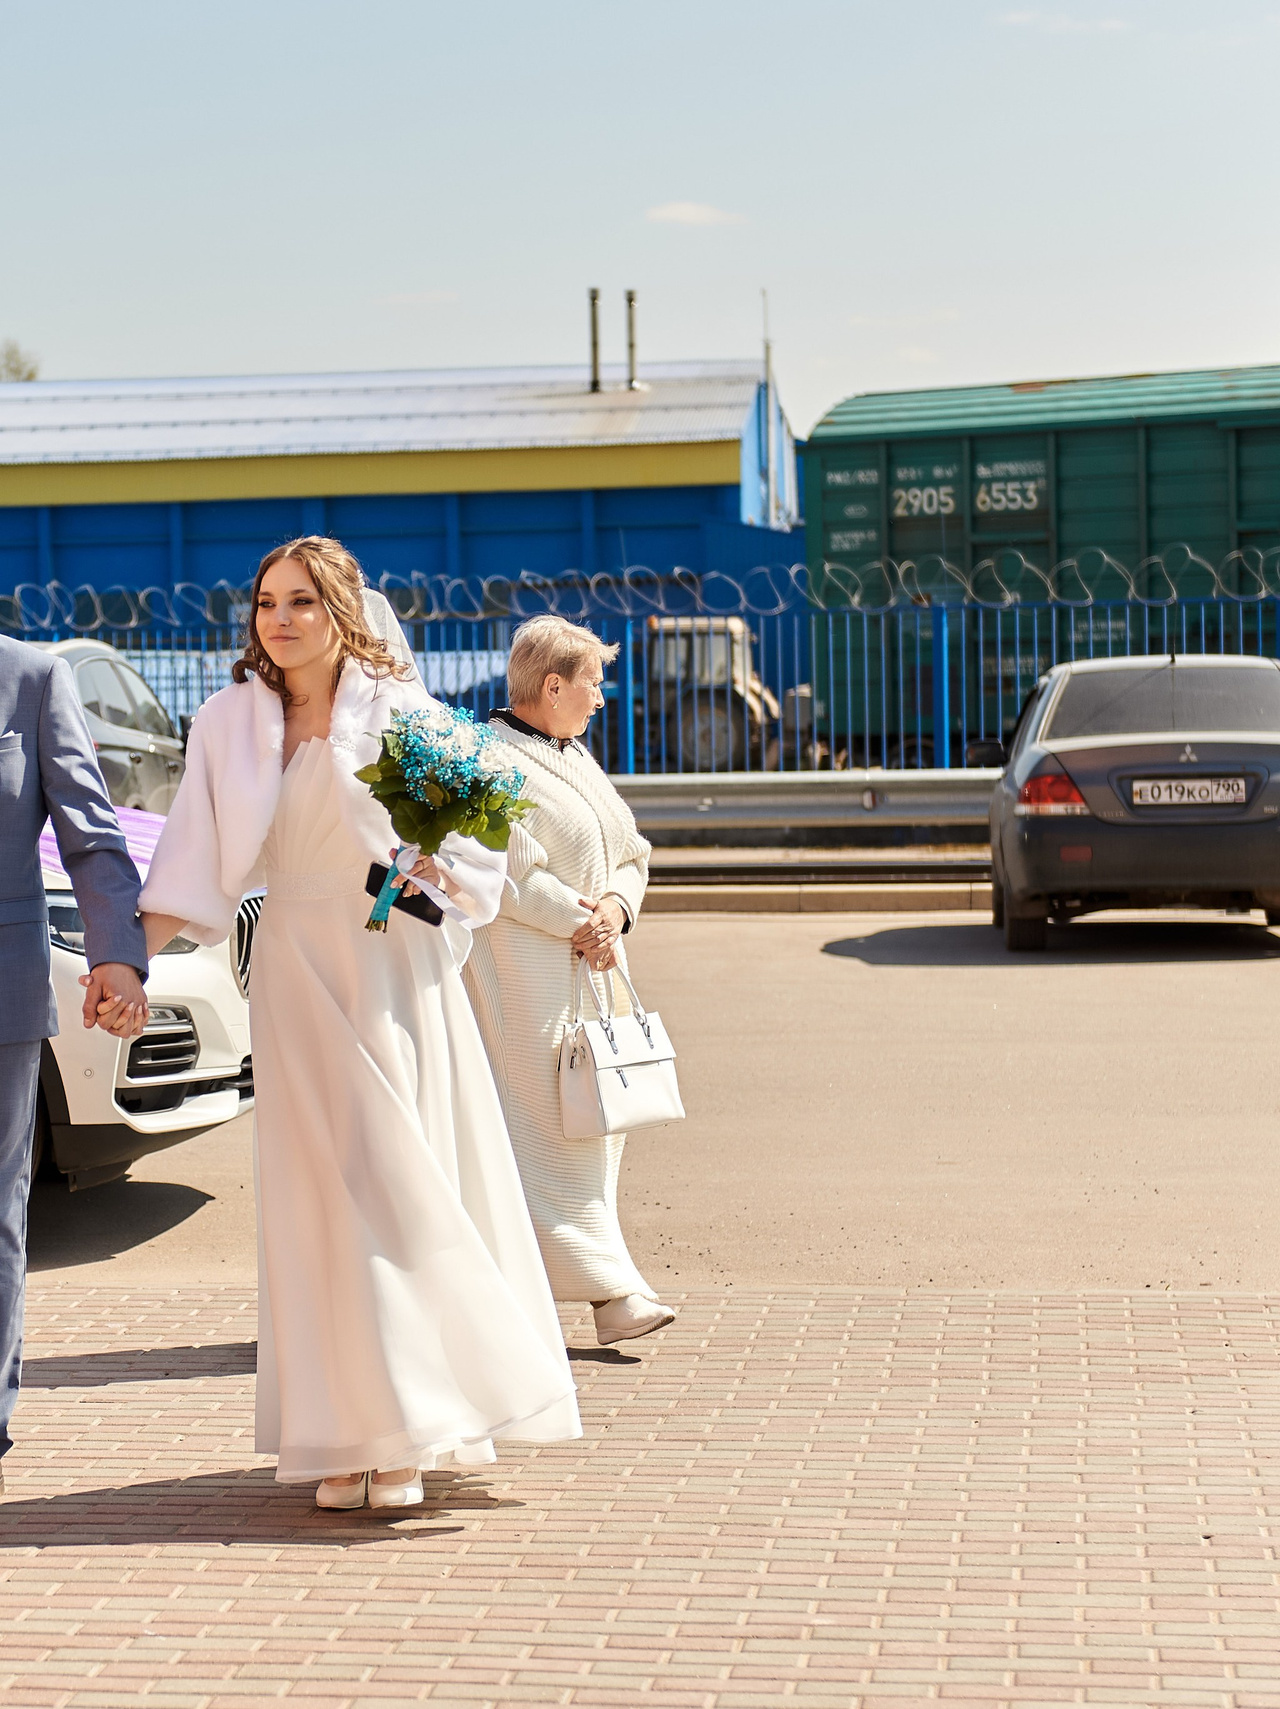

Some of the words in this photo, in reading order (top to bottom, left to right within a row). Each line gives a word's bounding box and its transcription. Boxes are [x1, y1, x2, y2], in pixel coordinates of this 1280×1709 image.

[892, 486, 956, 517] 2905
[976, 481, 1039, 512] 6553
[1213, 781, 1241, 796] 790
